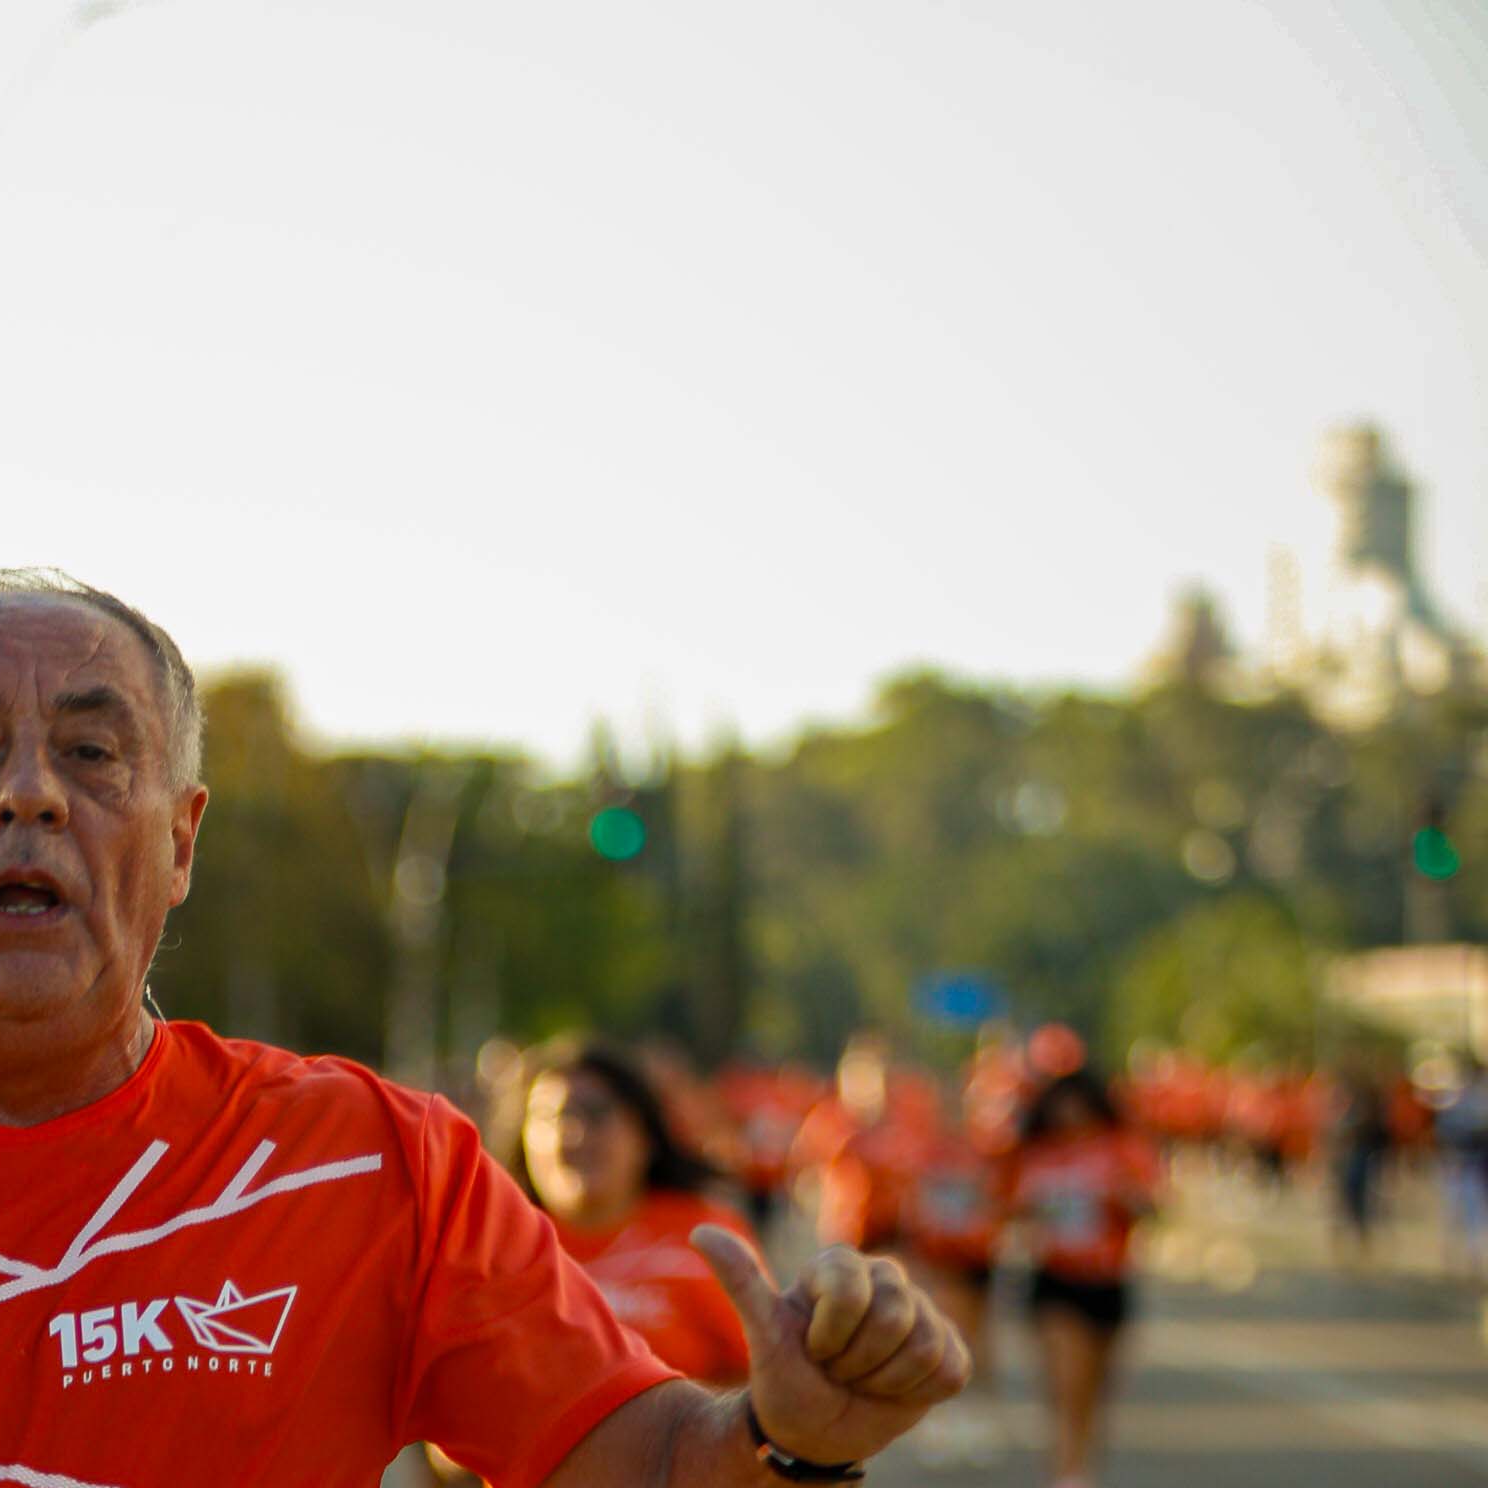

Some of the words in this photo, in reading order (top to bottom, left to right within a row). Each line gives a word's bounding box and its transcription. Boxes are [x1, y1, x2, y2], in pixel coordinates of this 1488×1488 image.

[49, 1299, 173, 1369] 15K
[63, 1358, 174, 1388] PUERTO
[187, 1356, 273, 1378] NORTE
